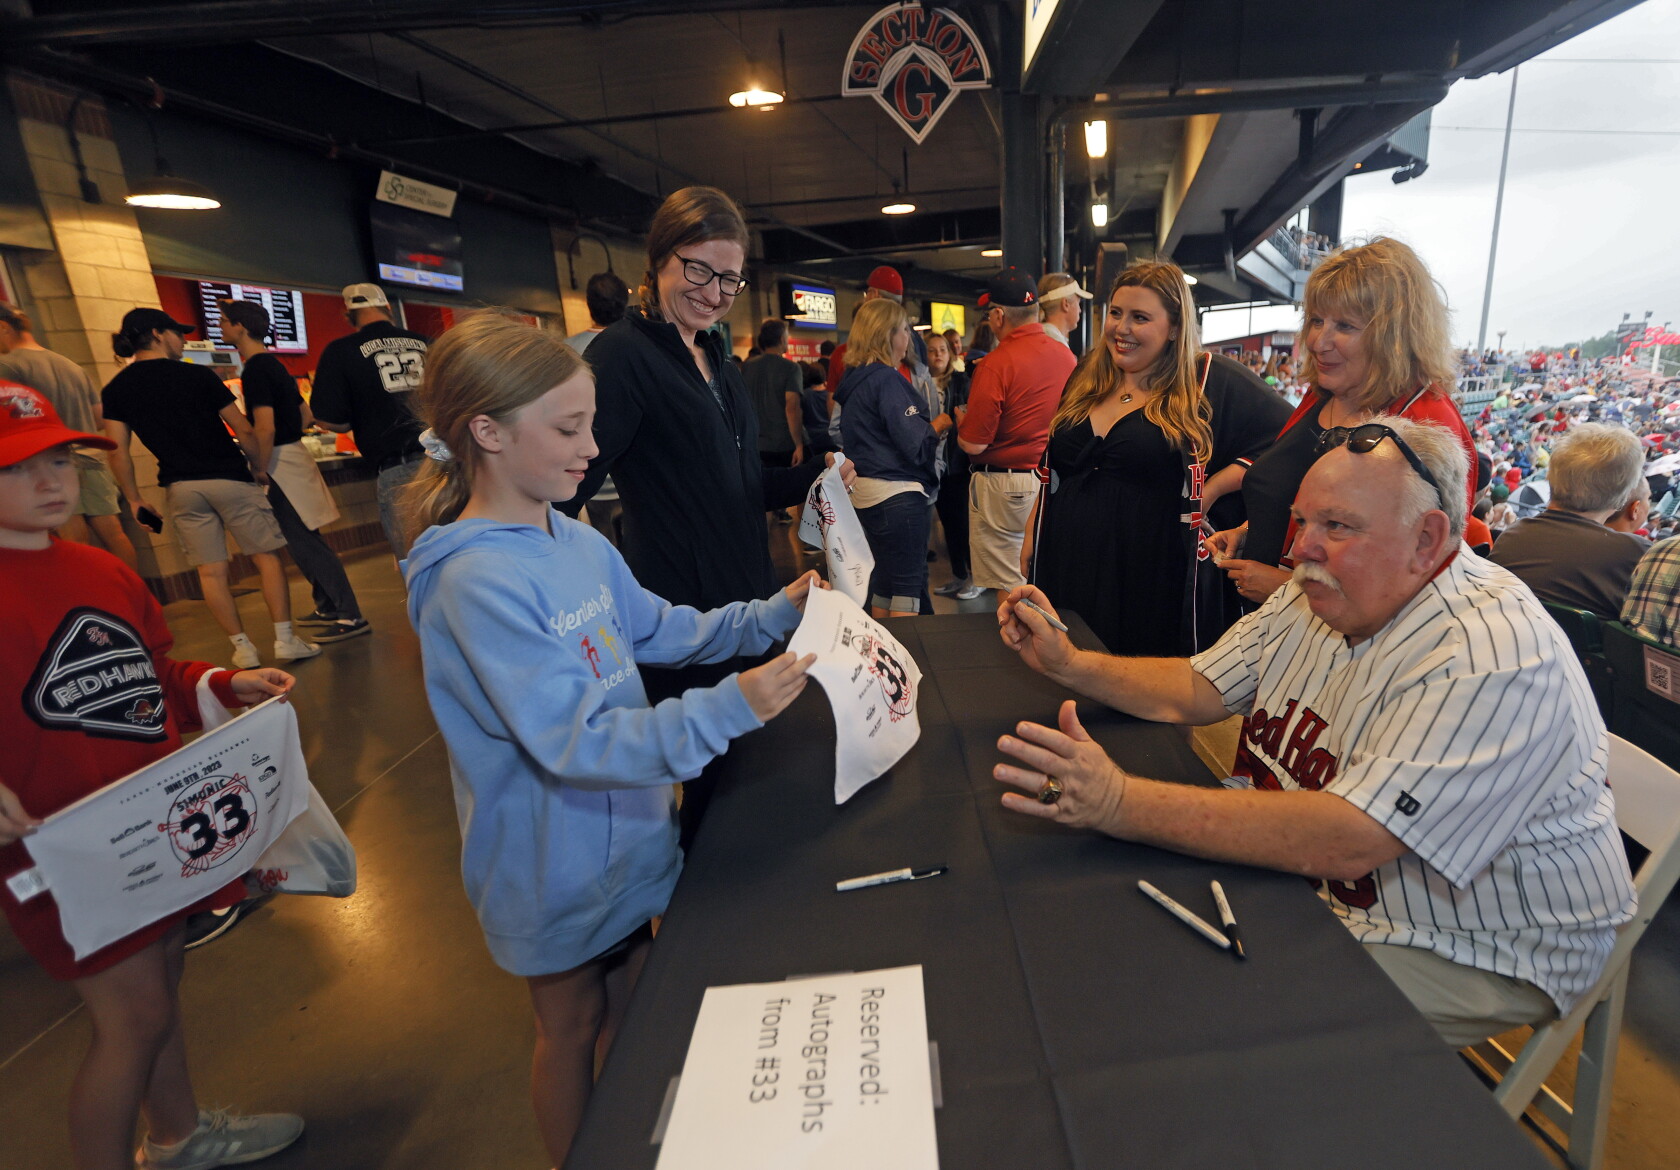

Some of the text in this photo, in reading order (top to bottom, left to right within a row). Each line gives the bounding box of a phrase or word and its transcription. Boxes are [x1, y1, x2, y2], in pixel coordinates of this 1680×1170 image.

[851, 8, 980, 83] SECTION
[894, 62, 936, 121] G
[805, 294, 835, 313] FARGO
[374, 351, 425, 393] 23
[874, 646, 908, 704] 33
[164, 780, 185, 796] JUNE
[201, 760, 222, 776] 2023
[176, 778, 226, 812] SIMONIC
[180, 793, 250, 860] 33
[749, 997, 791, 1105] from #33
[798, 992, 837, 1134] Autographs
[859, 986, 889, 1106] Reserved:
